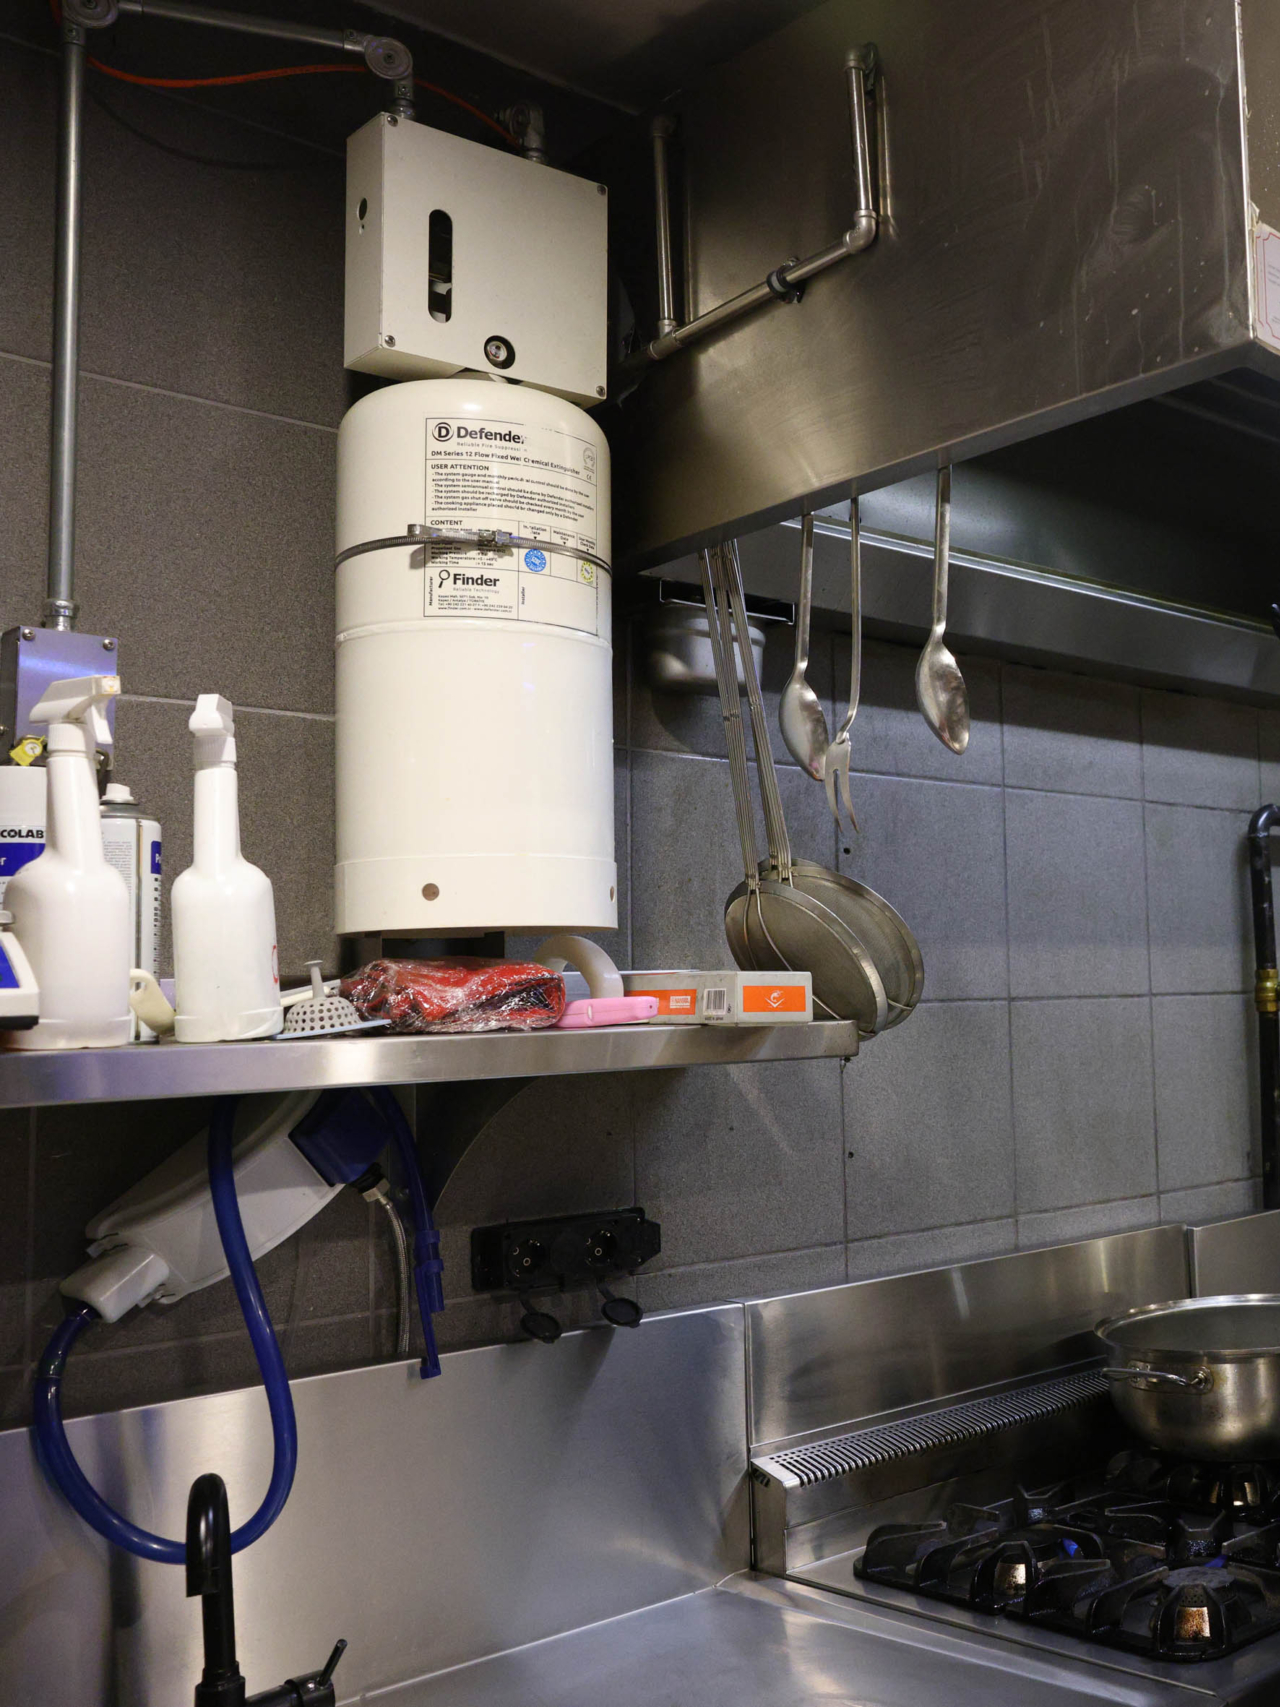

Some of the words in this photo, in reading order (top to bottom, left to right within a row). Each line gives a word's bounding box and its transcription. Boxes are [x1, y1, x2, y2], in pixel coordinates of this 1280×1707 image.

[495, 444, 527, 452] Suppressin
[453, 573, 500, 587] Finder
[0, 829, 44, 839] COLAB
